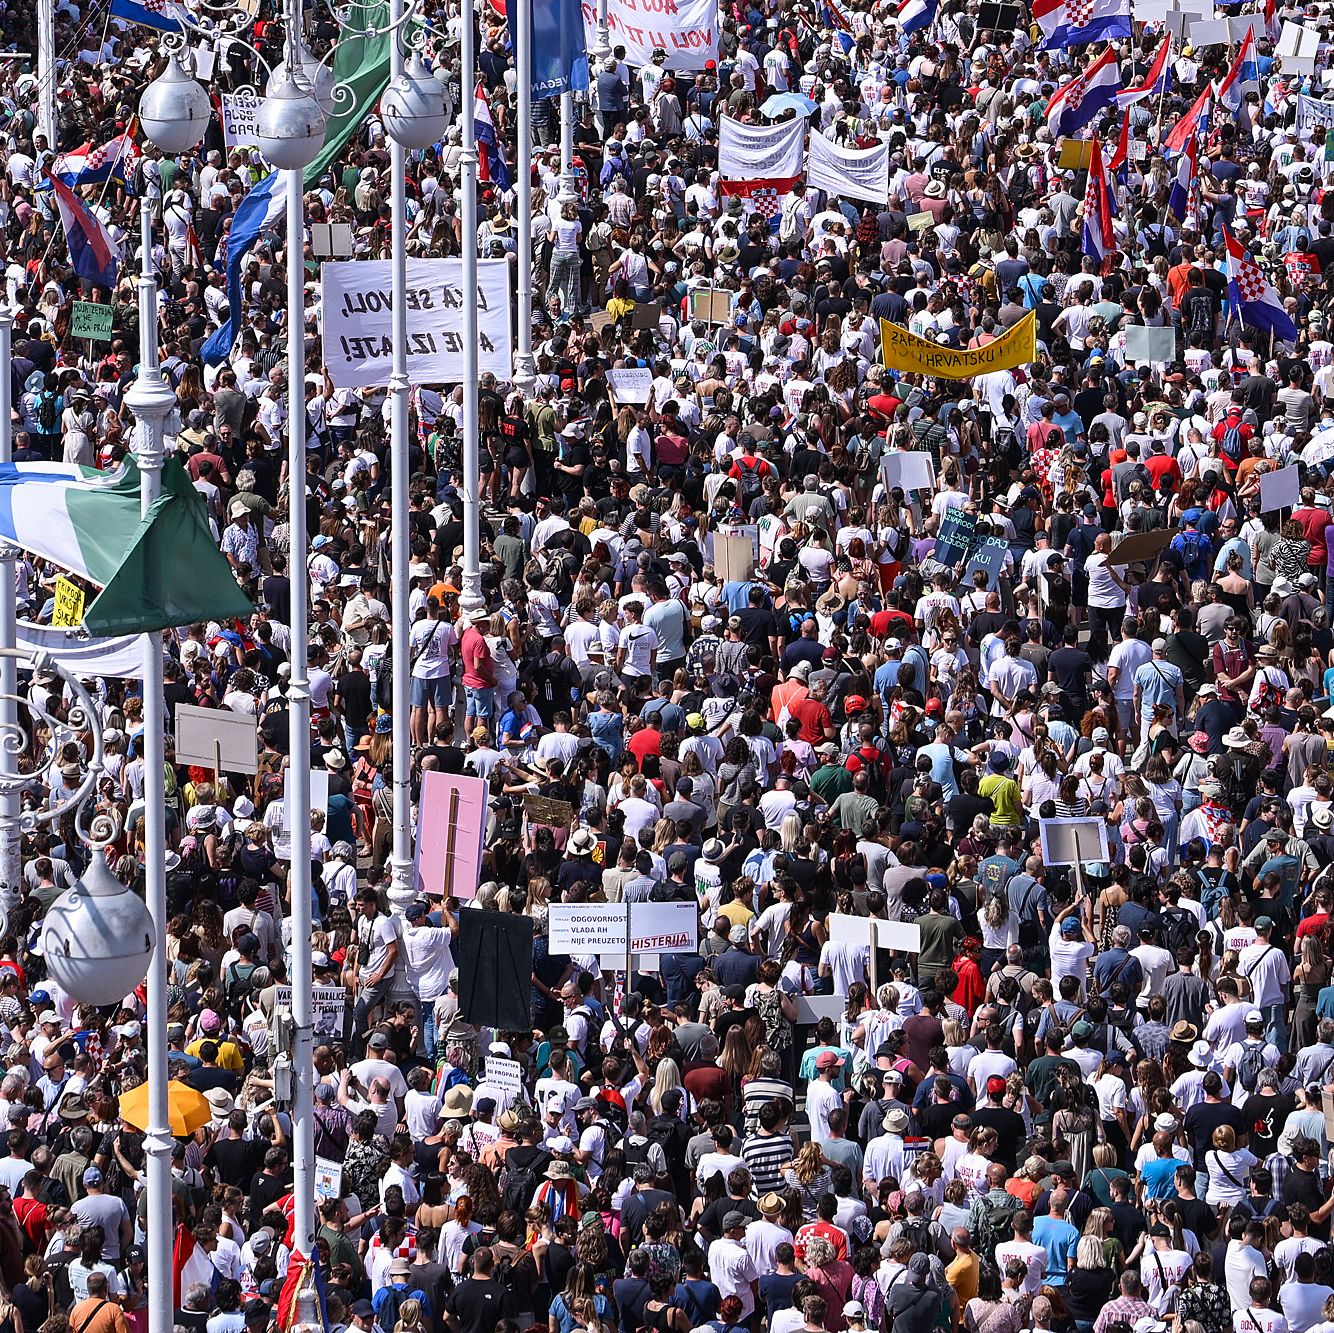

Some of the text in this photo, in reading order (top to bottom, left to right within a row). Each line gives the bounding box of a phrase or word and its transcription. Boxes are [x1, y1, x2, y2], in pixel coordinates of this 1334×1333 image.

[925, 349, 995, 369] HRVATSKU
[970, 533, 1010, 551] HODAJ
[570, 915, 627, 924] ODGOVORNOST
[570, 925, 608, 934] VLADA RH
[570, 936, 626, 946] NIJE PREUZETO
[631, 932, 689, 950] HISTERIJA
[317, 988, 345, 1003] VARALICE
[494, 1069, 520, 1080] PROPALA
[1152, 1267, 1174, 1279] DOTA
